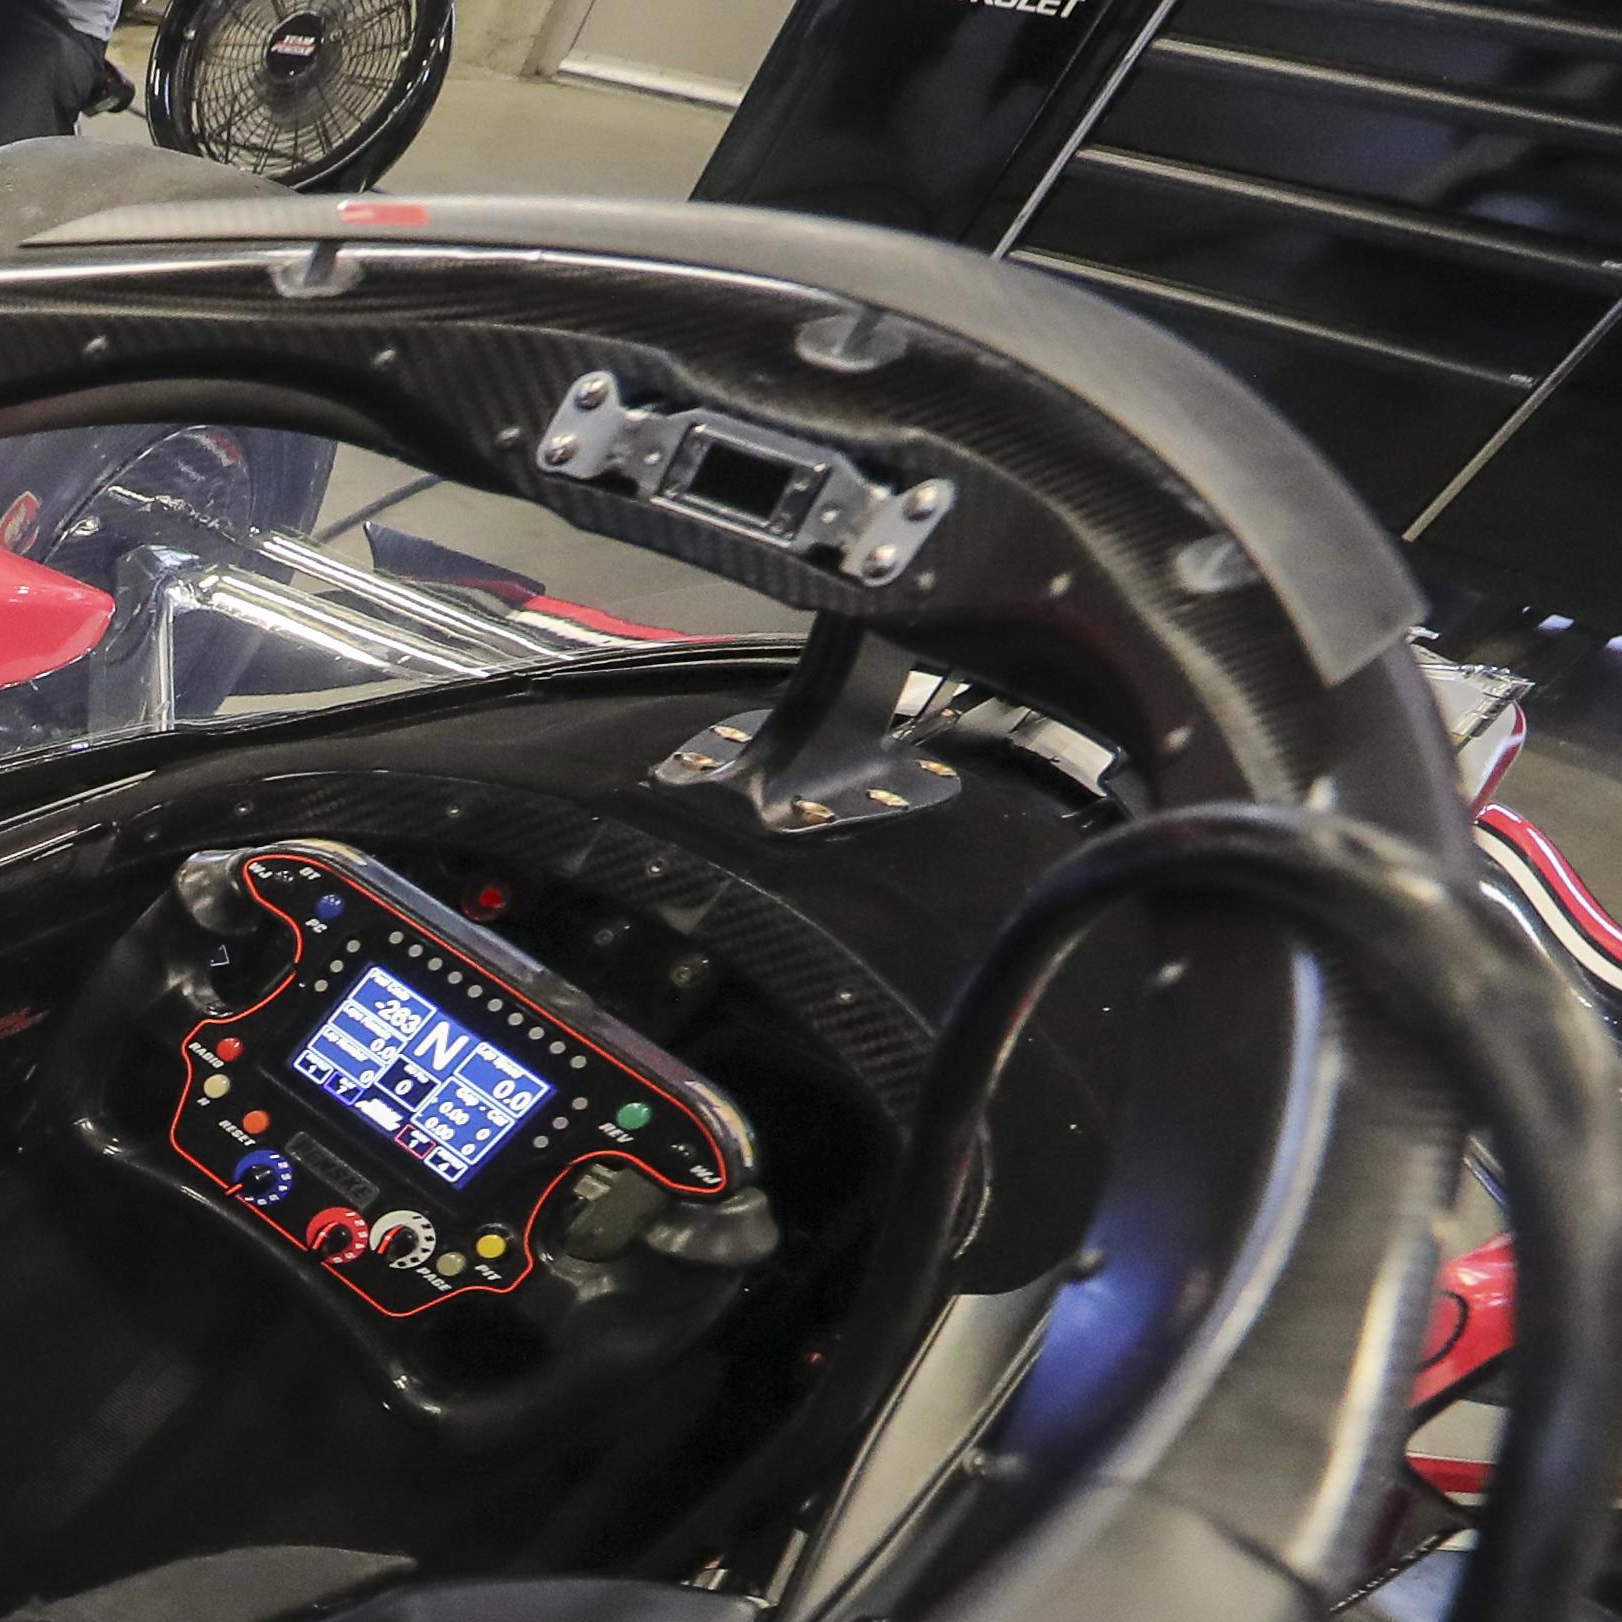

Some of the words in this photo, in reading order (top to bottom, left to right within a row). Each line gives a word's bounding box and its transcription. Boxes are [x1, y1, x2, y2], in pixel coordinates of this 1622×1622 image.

[188, 1041, 224, 1069] RADIO
[413, 1021, 470, 1071] N
[394, 1079, 414, 1096] 0
[492, 1079, 533, 1111] 0.0
[218, 1119, 257, 1147] RESET
[598, 1122, 635, 1144] REV
[415, 1266, 453, 1292] PAGE
[474, 1263, 503, 1281] PIT
